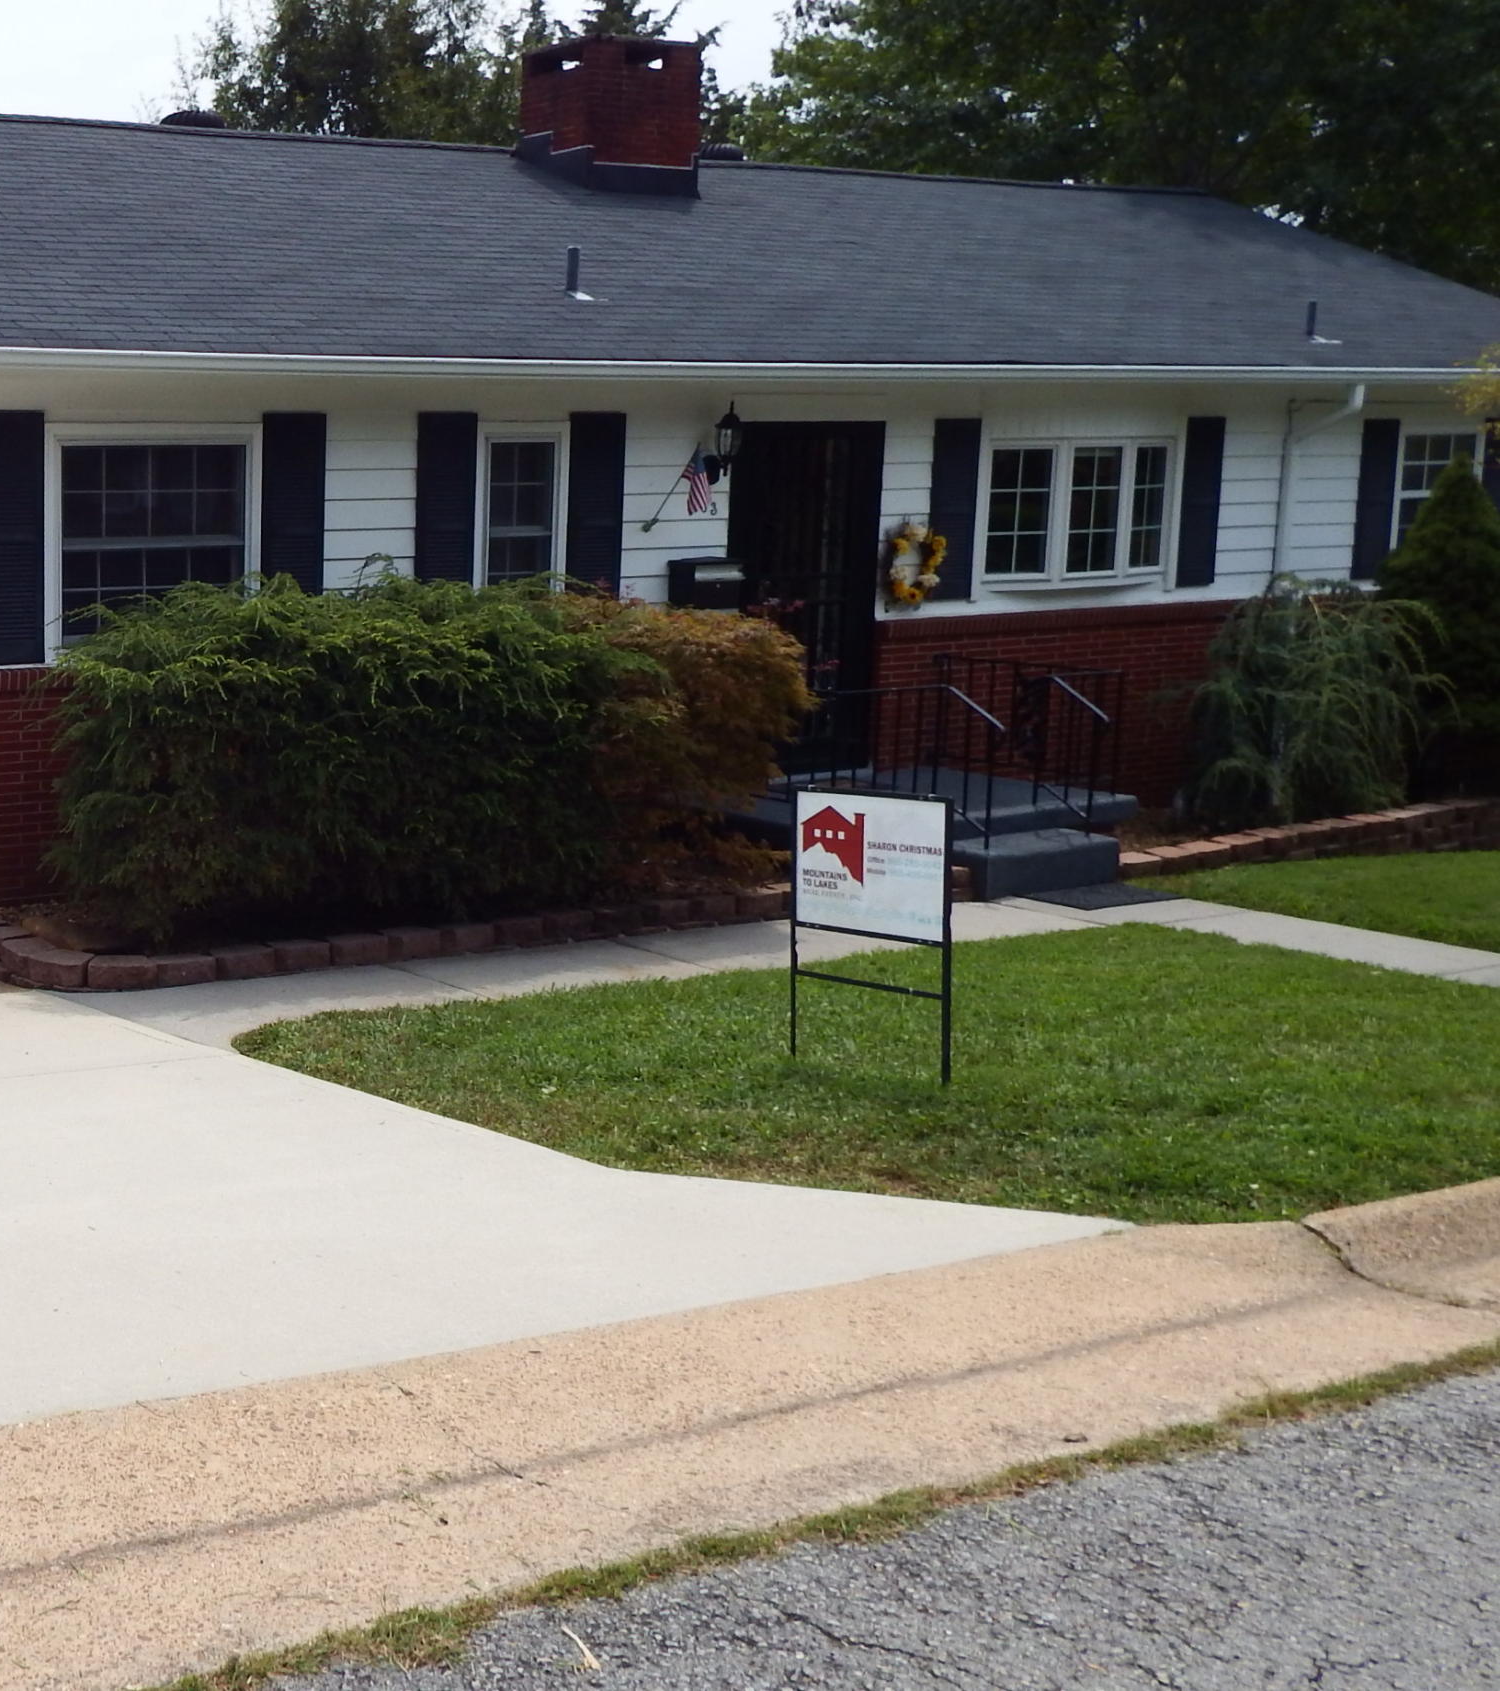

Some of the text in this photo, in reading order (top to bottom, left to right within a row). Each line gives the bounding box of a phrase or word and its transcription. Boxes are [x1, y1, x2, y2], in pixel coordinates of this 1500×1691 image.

[867, 841, 943, 856] SHARON CHRISTMAS
[802, 868, 848, 882] MOUNTAINS
[802, 877, 838, 890] TO LAKES
